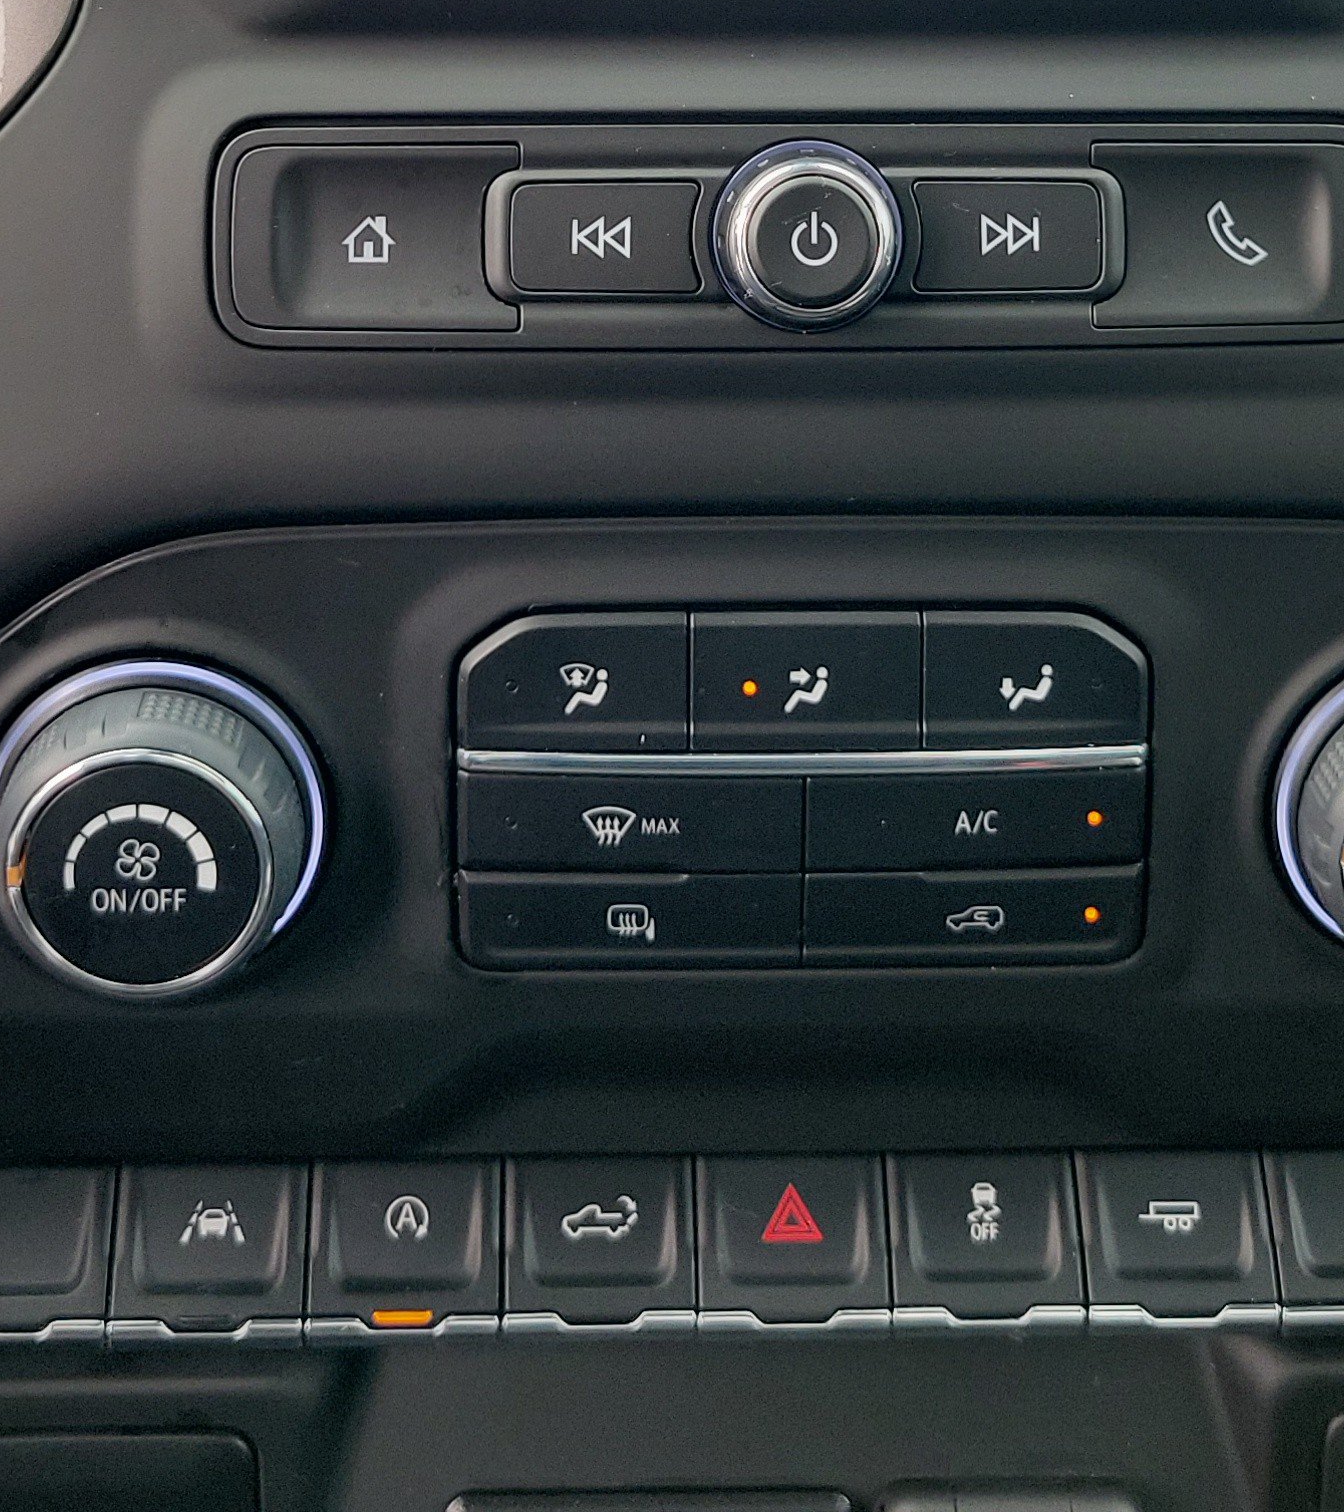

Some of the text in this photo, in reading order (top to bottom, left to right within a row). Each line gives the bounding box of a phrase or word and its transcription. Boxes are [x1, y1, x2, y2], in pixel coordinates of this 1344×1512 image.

[641, 817, 681, 835] MAX
[955, 809, 999, 835] A/C
[91, 888, 188, 914] ON/OFF
[395, 1202, 418, 1231] A
[970, 1221, 1000, 1242] OFF
